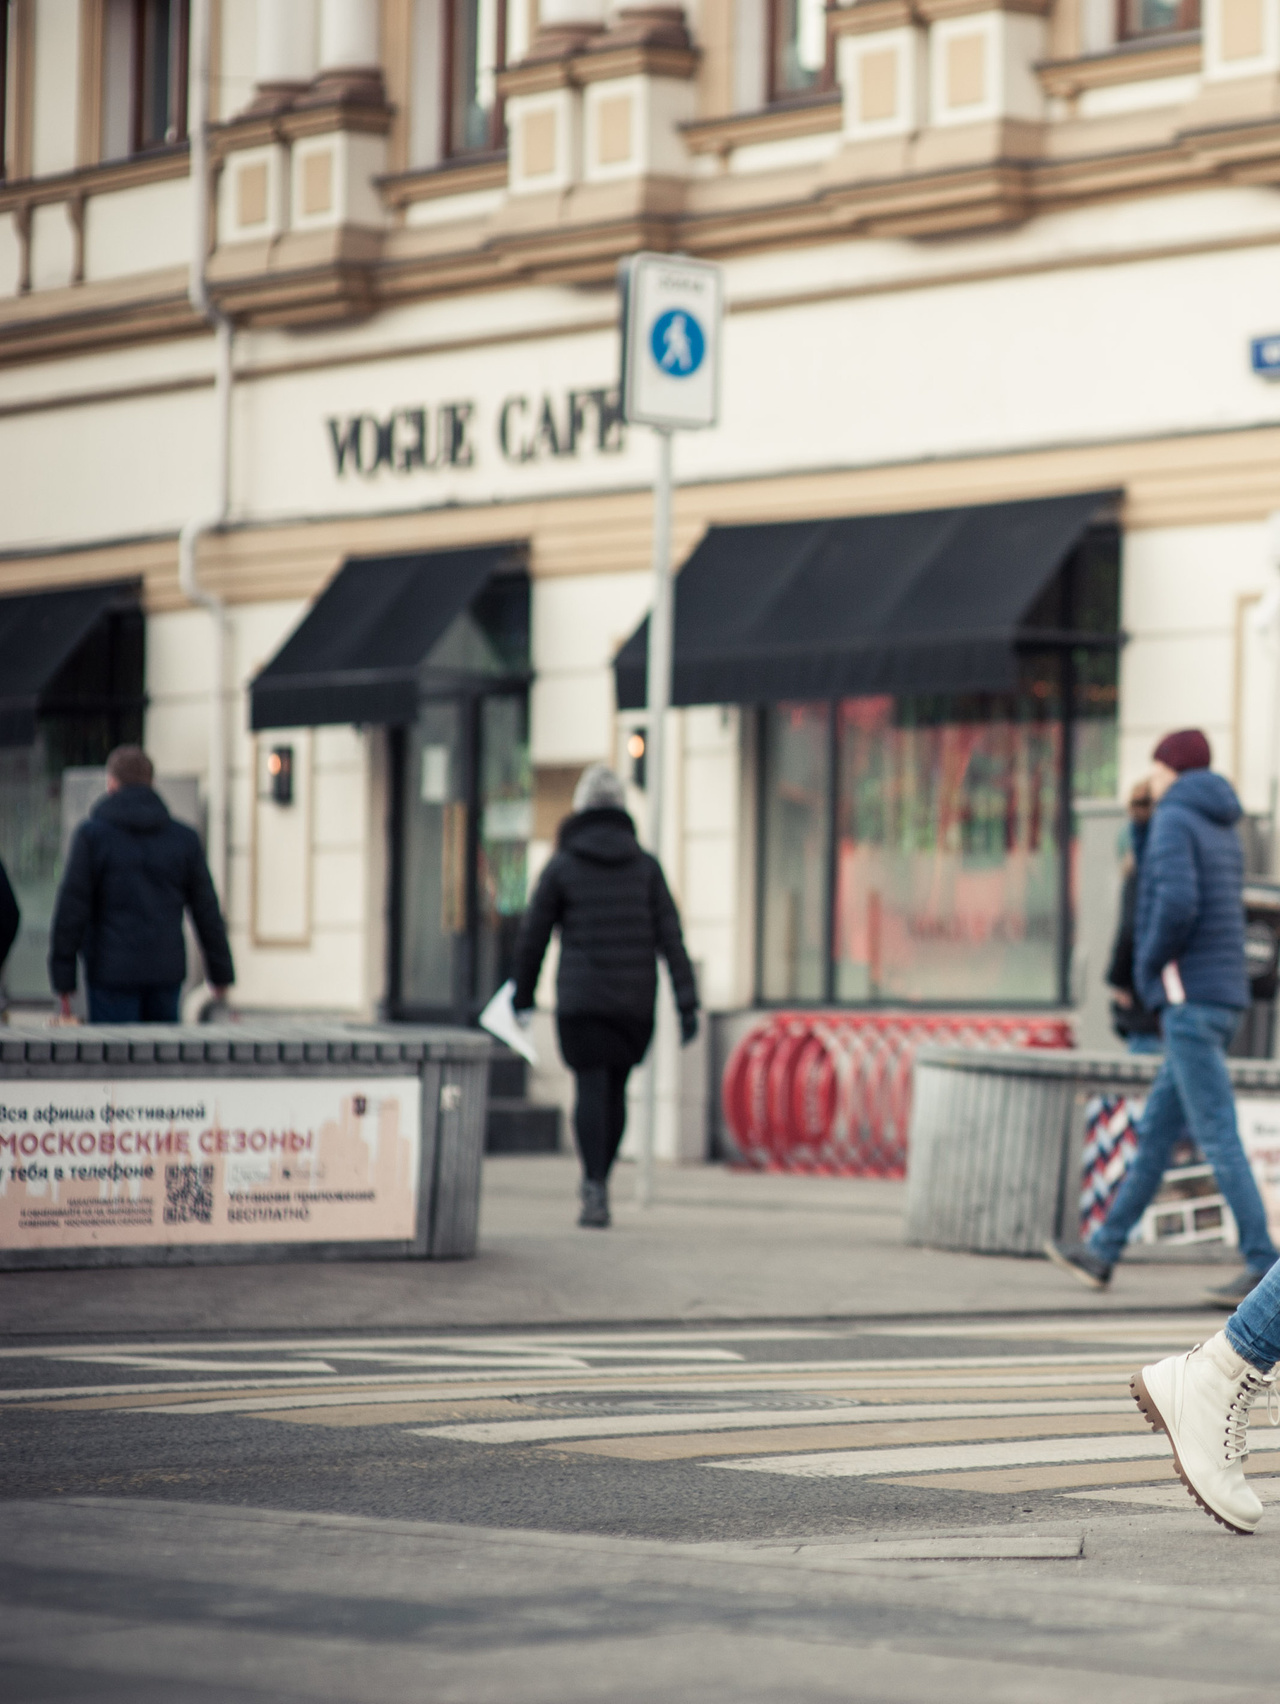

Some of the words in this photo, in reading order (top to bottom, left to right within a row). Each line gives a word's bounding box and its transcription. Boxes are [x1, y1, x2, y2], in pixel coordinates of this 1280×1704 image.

[326, 399, 474, 476] VOGUE
[33, 1102, 95, 1125] афиша
[101, 1101, 206, 1125] фестивалей
[0, 1131, 190, 1155] МОСКОВСКИЕ
[199, 1129, 312, 1153] СЕЗОНЫ
[10, 1162, 48, 1182] тебя
[54, 1167, 64, 1181] в
[71, 1162, 154, 1183] телефоне
[227, 1207, 309, 1223] БЕСПЛАТНО
